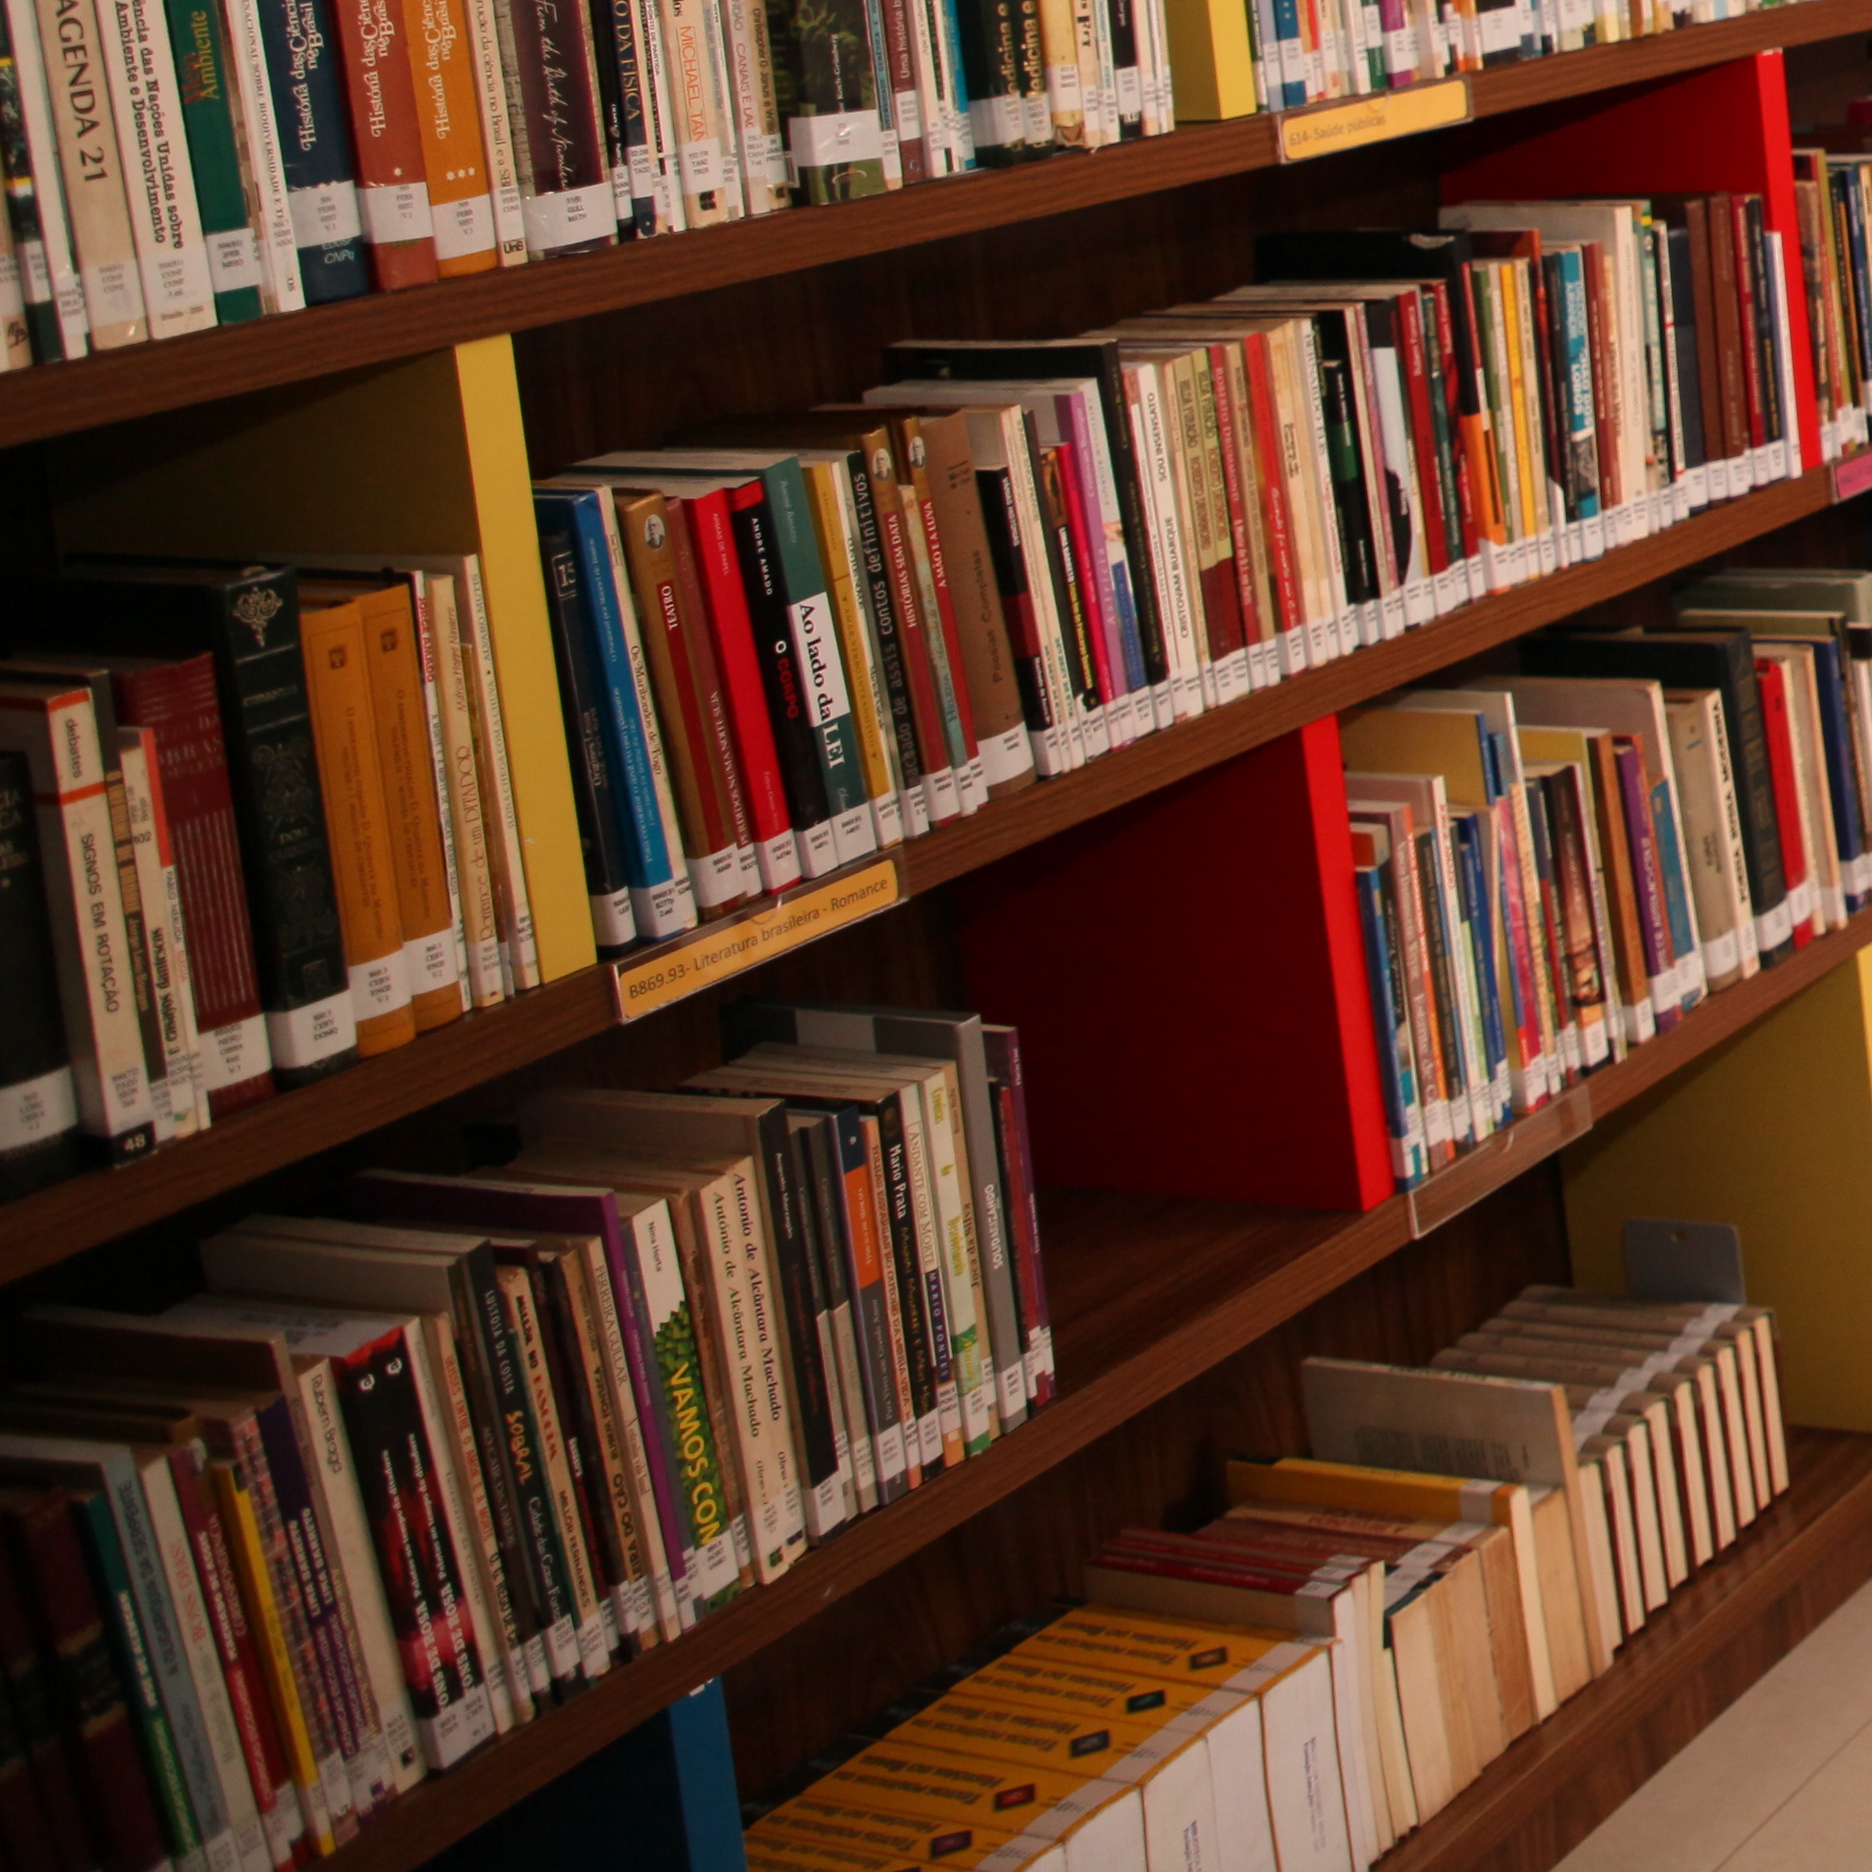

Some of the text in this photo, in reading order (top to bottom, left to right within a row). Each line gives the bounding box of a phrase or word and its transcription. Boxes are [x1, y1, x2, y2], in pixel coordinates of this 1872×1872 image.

[114, 1, 136, 76] Ambiente
[201, 10, 218, 99] Ambiente
[300, 2, 324, 48] Brasil
[360, 43, 376, 67] das
[426, 46, 441, 71] das
[616, 18, 632, 45] DA
[892, 6, 907, 47] história
[130, 81, 140, 93] e
[141, 47, 154, 73] das
[290, 53, 306, 81] das
[679, 25, 697, 106] MICHAEL
[898, 50, 909, 79] Uma
[146, 78, 165, 137] Nações
[296, 84, 317, 152] História
[364, 71, 386, 138] História
[428, 75, 450, 140] História
[80, 146, 108, 182] 21
[131, 97, 167, 245] Desenvolvimento
[157, 140, 176, 203] Unidas
[169, 205, 184, 250] sobre
[853, 472, 893, 634] contos definitivos
[887, 514, 917, 628] HISTÓRIAS SEM DATA
[1164, 517, 1189, 639] CRISTOVAM BUARQUE
[774, 639, 799, 720] O CORPO
[799, 603, 845, 768] Ao lado da LEI
[65, 717, 82, 780] debates
[81, 833, 120, 1013] SIGNOS EM ROTAÇÃO
[692, 934, 758, 971] Literatura
[762, 908, 819, 942] brasileira
[831, 878, 888, 909] Romance
[123, 1132, 146, 1151] 48
[890, 1145, 905, 1220] Mario Prata
[724, 1259, 735, 1278] de
[731, 1173, 780, 1423] Antonio de Alcântara Machado
[727, 1286, 749, 1358] Alcântara
[311, 1375, 342, 1475] Rubem Braga
[667, 1363, 706, 1478] VAMOS
[740, 1362, 759, 1439] Machado
[506, 1410, 534, 1486] SOBRAL
